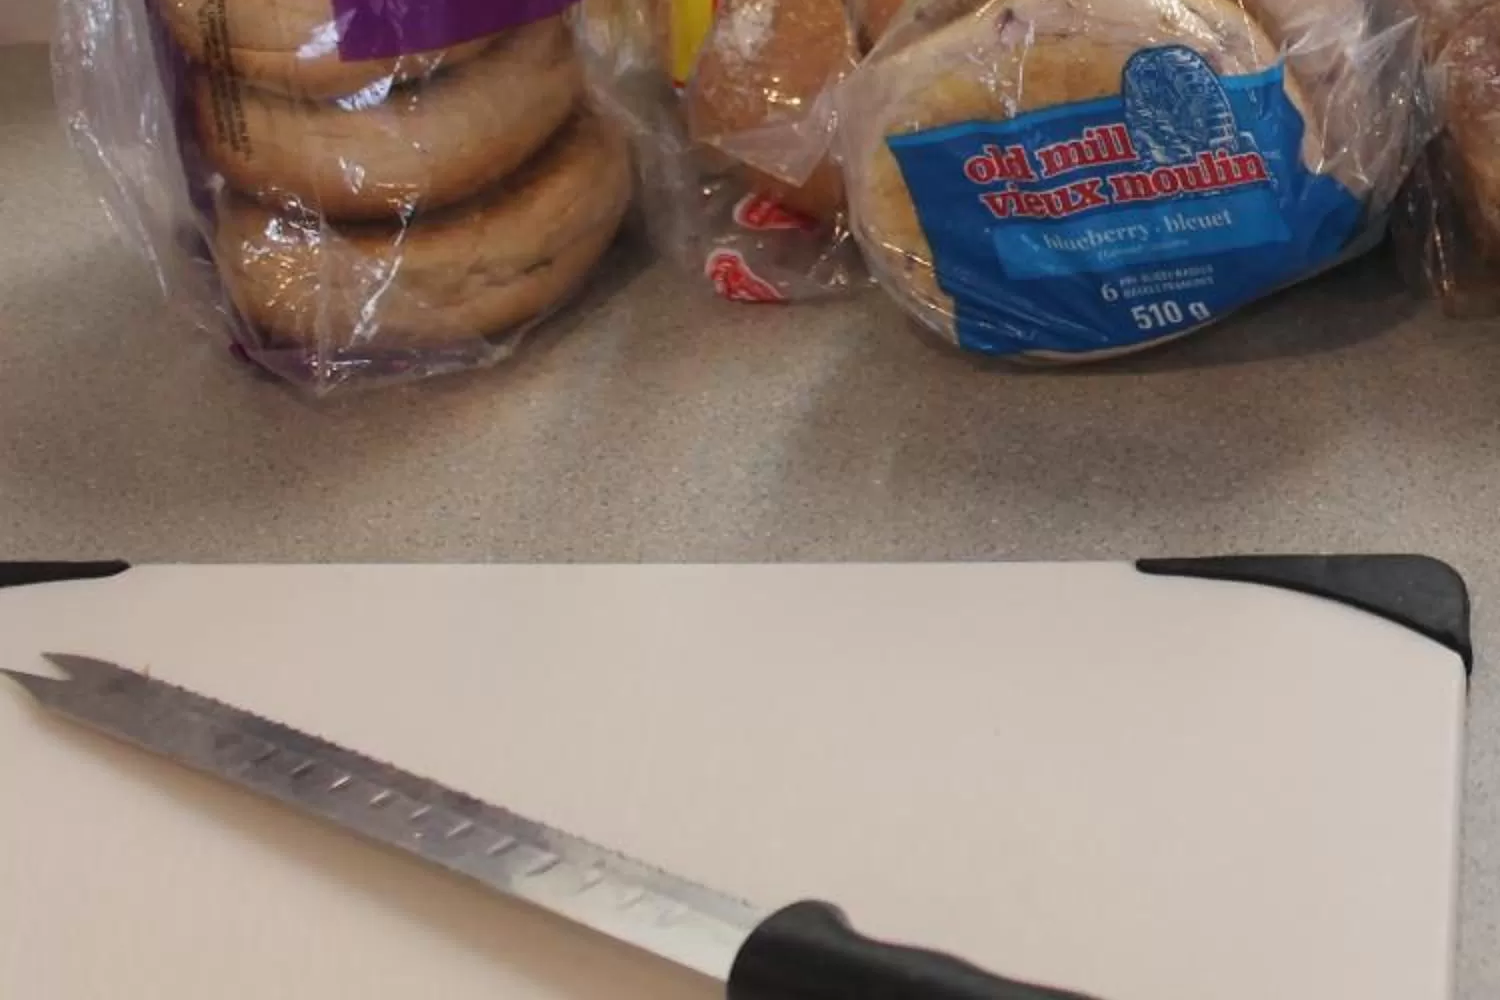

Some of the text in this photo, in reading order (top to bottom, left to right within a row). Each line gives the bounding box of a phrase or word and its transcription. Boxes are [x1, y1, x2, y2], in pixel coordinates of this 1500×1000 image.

[963, 122, 1140, 184] old mill
[978, 145, 1272, 219] vieux moulin
[1042, 222, 1150, 251] blueberry
[1162, 208, 1234, 234] bleuet
[1101, 283, 1119, 302] 6
[1130, 300, 1183, 330] 510
